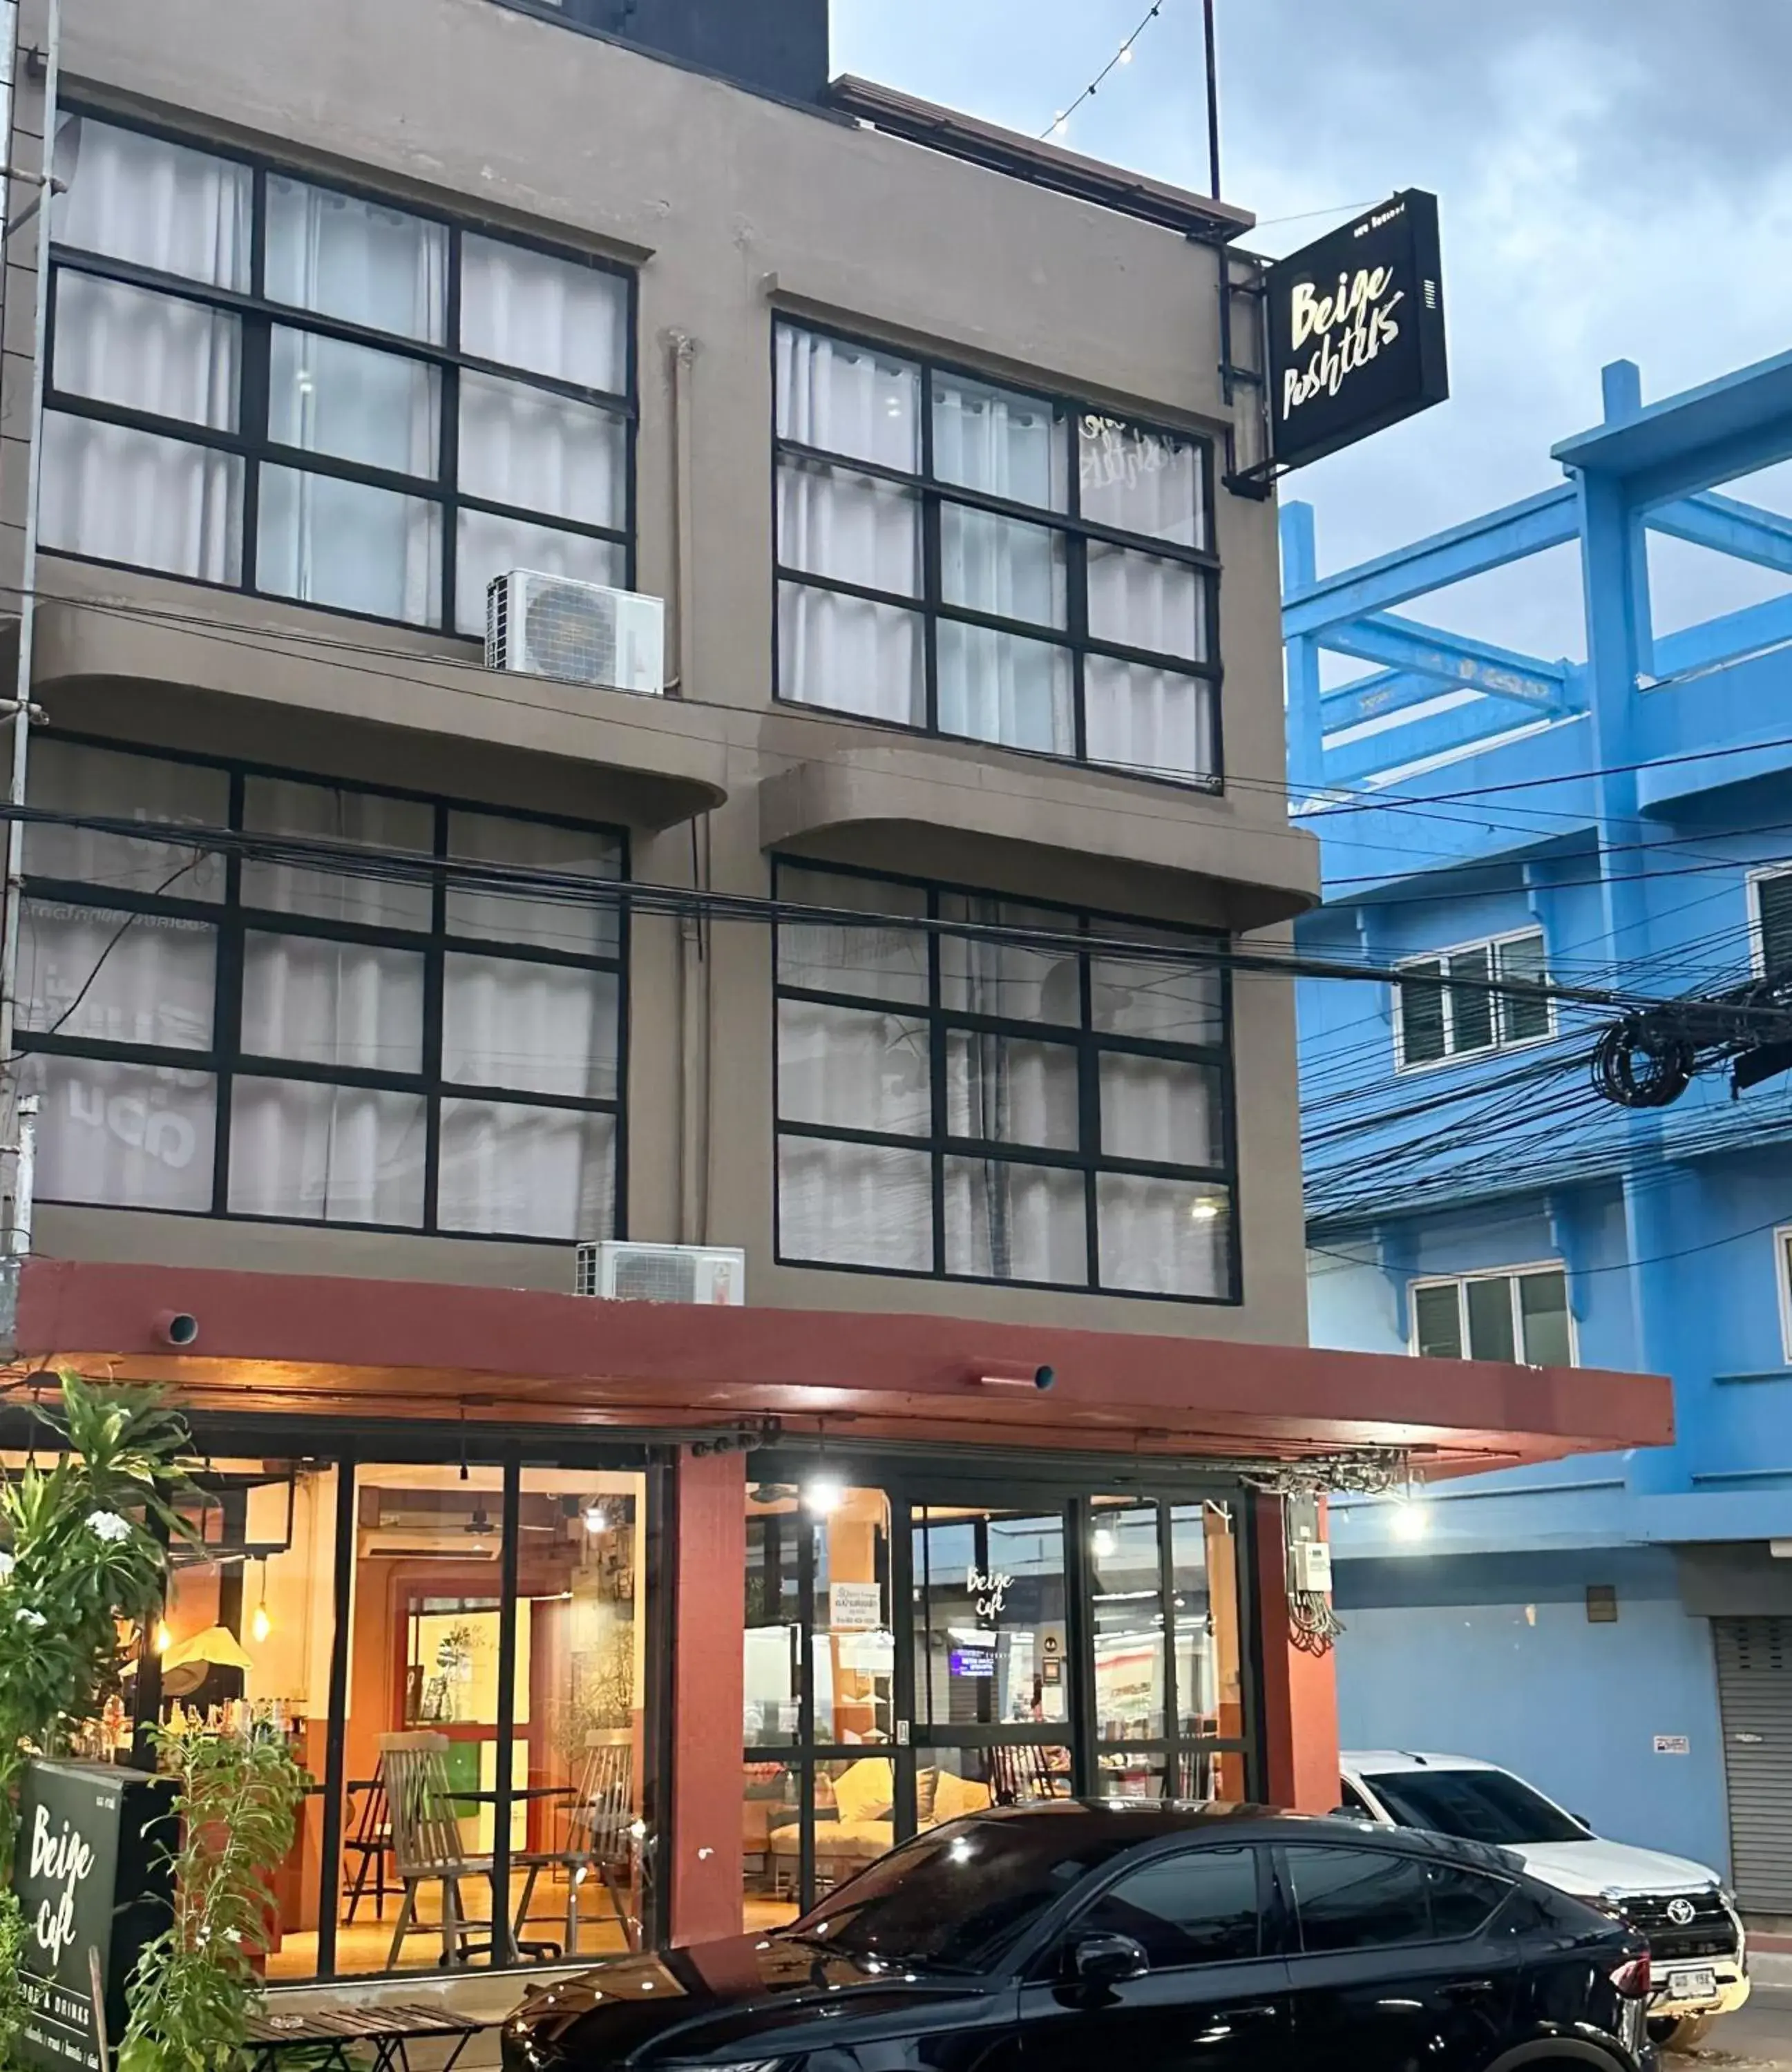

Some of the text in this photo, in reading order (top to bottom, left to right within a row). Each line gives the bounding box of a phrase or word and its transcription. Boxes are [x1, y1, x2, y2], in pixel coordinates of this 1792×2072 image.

[1291, 265, 1393, 351] Beige
[967, 1565, 1016, 1595] Beige
[30, 1804, 95, 1897] Beige
